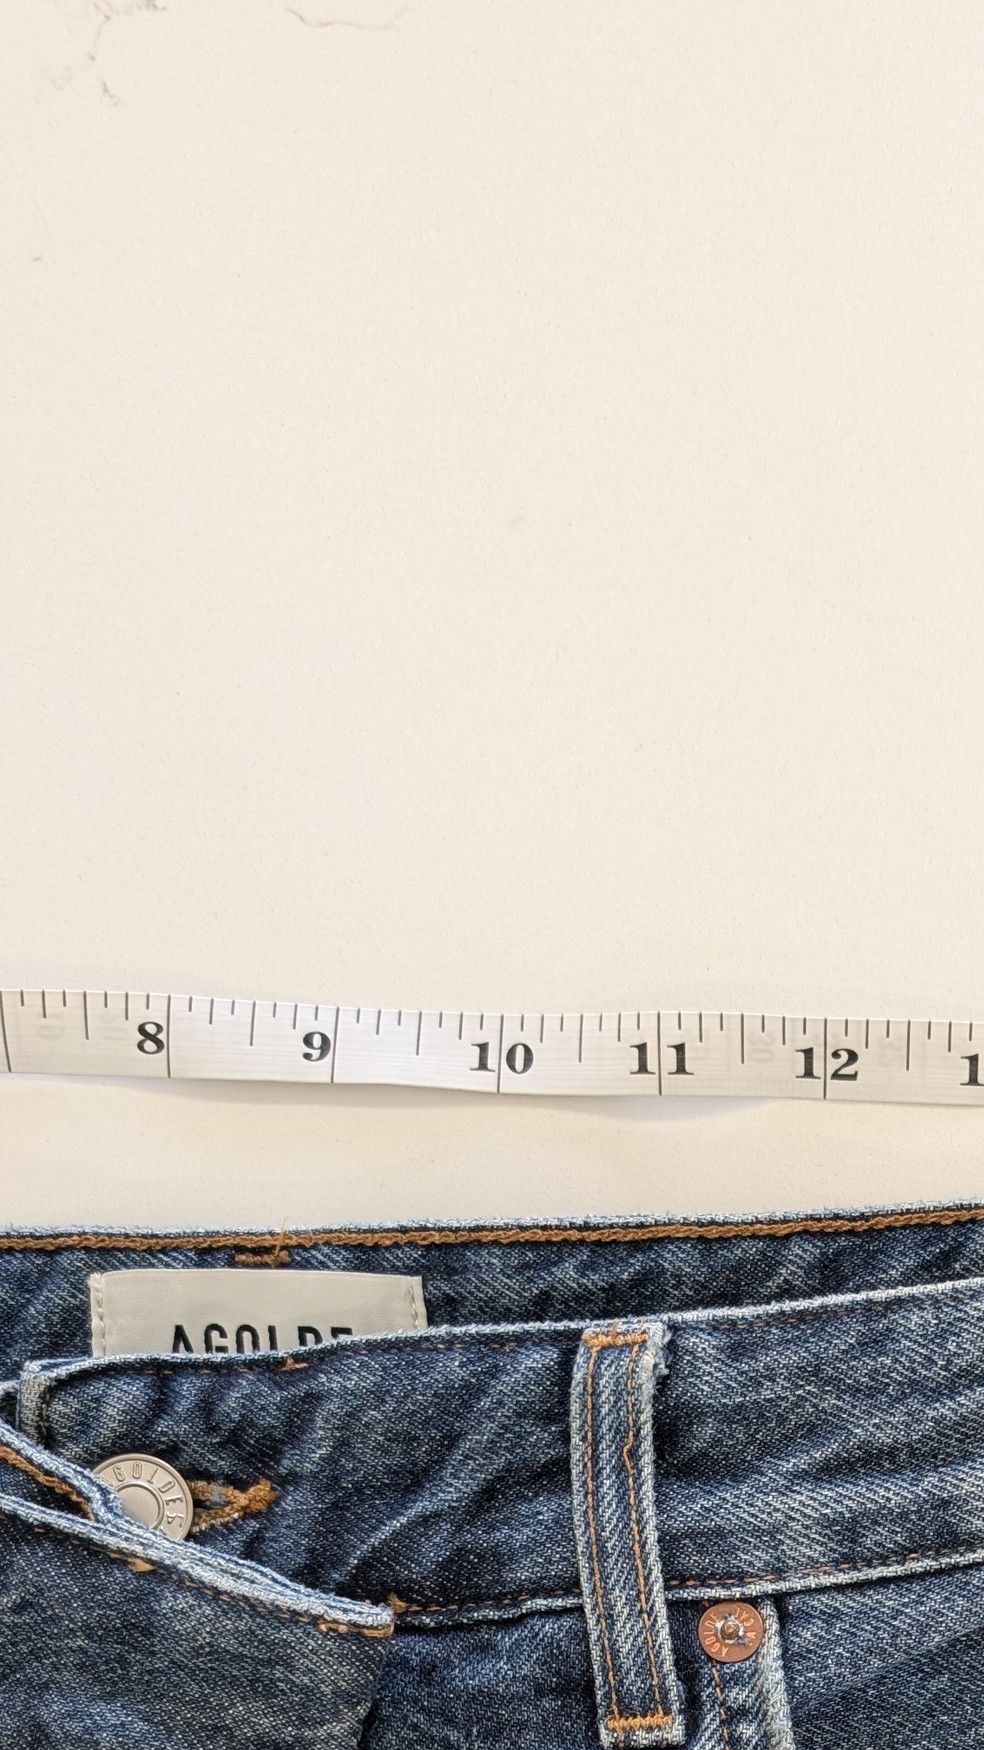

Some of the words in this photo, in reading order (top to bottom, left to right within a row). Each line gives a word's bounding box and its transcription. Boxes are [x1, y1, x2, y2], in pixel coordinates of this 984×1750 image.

[137, 1021, 165, 1055] 8
[302, 1031, 331, 1061] 9
[471, 1041, 534, 1074] 10
[630, 1042, 694, 1075] 11
[795, 1046, 859, 1081] 12
[172, 1322, 354, 1353] AGO
[108, 1461, 184, 1507] GOLDE
